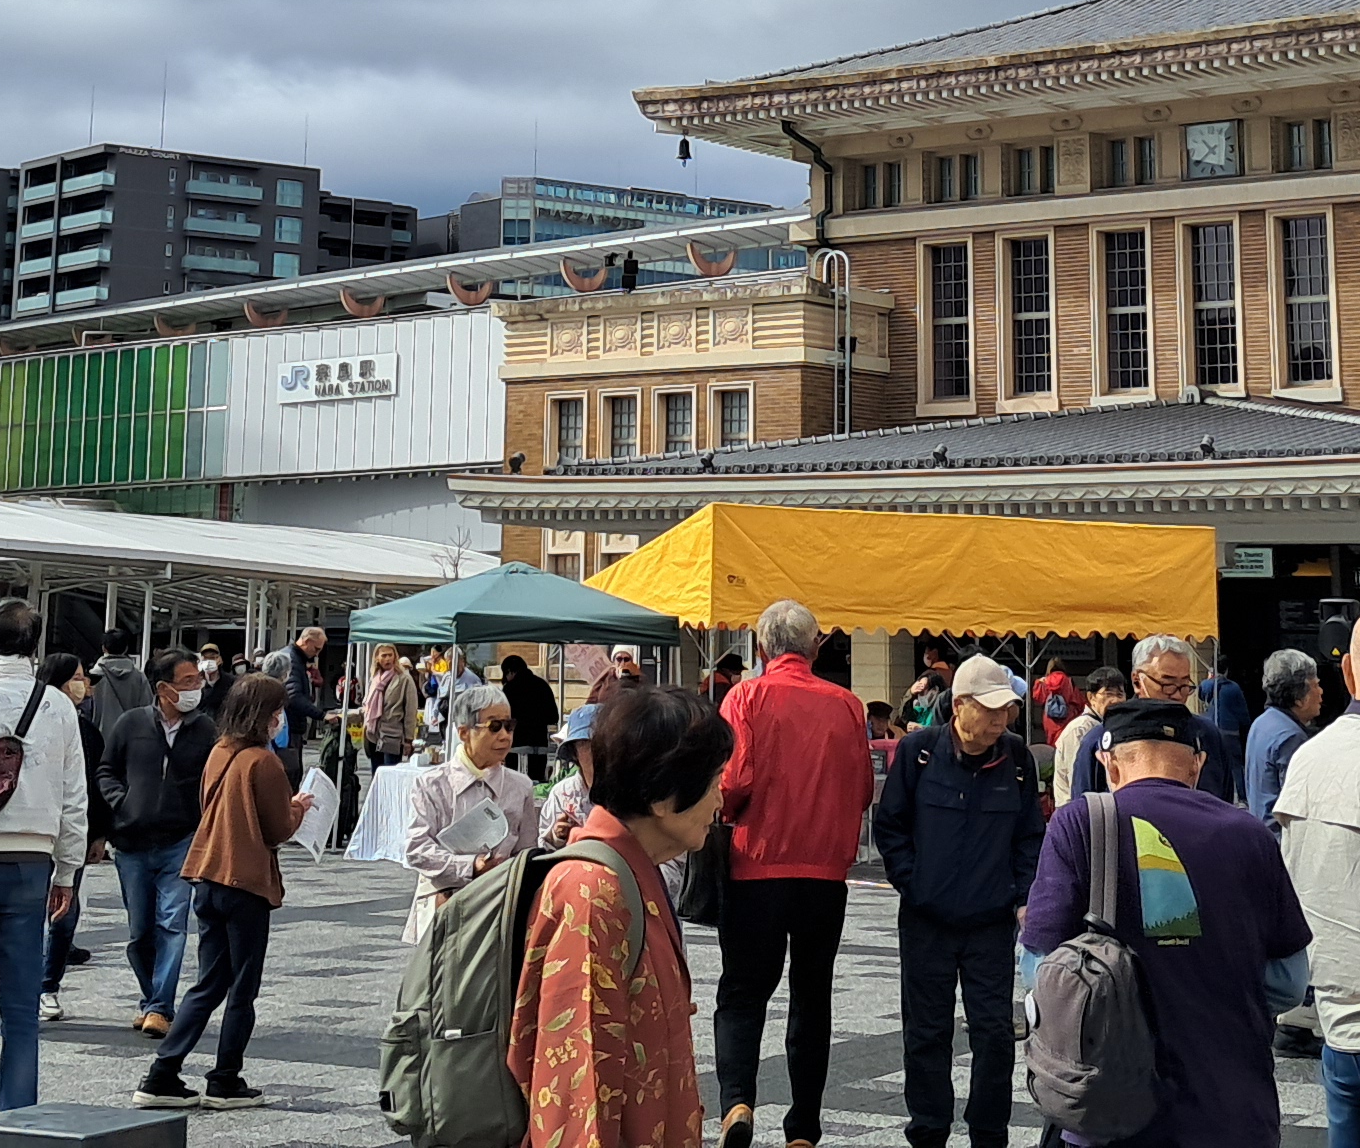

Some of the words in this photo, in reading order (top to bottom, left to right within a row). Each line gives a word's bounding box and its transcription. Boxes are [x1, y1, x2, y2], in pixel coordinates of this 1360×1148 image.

[281, 365, 311, 391] JR
[315, 359, 376, 383] 奈良駅
[314, 383, 344, 398] NARA
[347, 378, 393, 396] STATION
